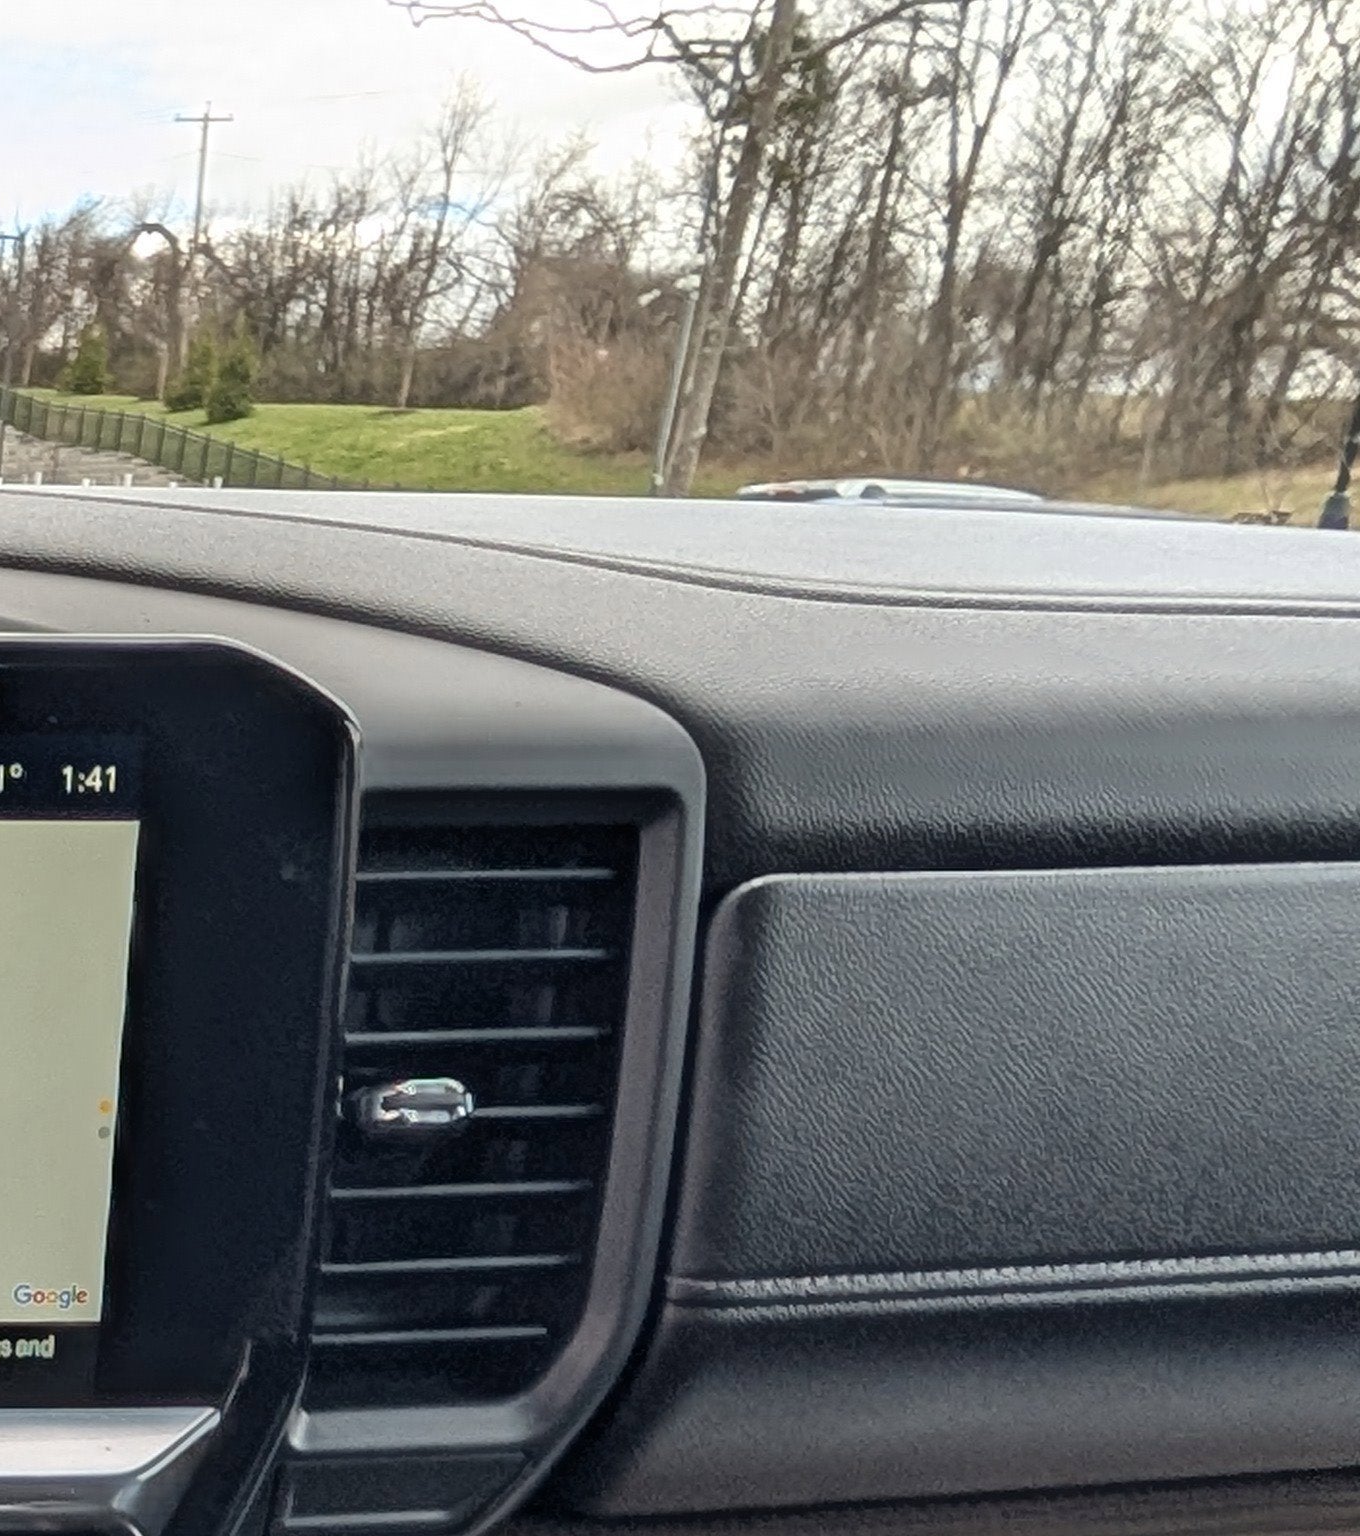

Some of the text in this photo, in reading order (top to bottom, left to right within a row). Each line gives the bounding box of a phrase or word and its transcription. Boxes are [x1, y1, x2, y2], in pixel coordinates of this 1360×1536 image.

[62, 764, 116, 793] 1:41
[13, 1284, 88, 1308] Google
[15, 1336, 54, 1358] and
